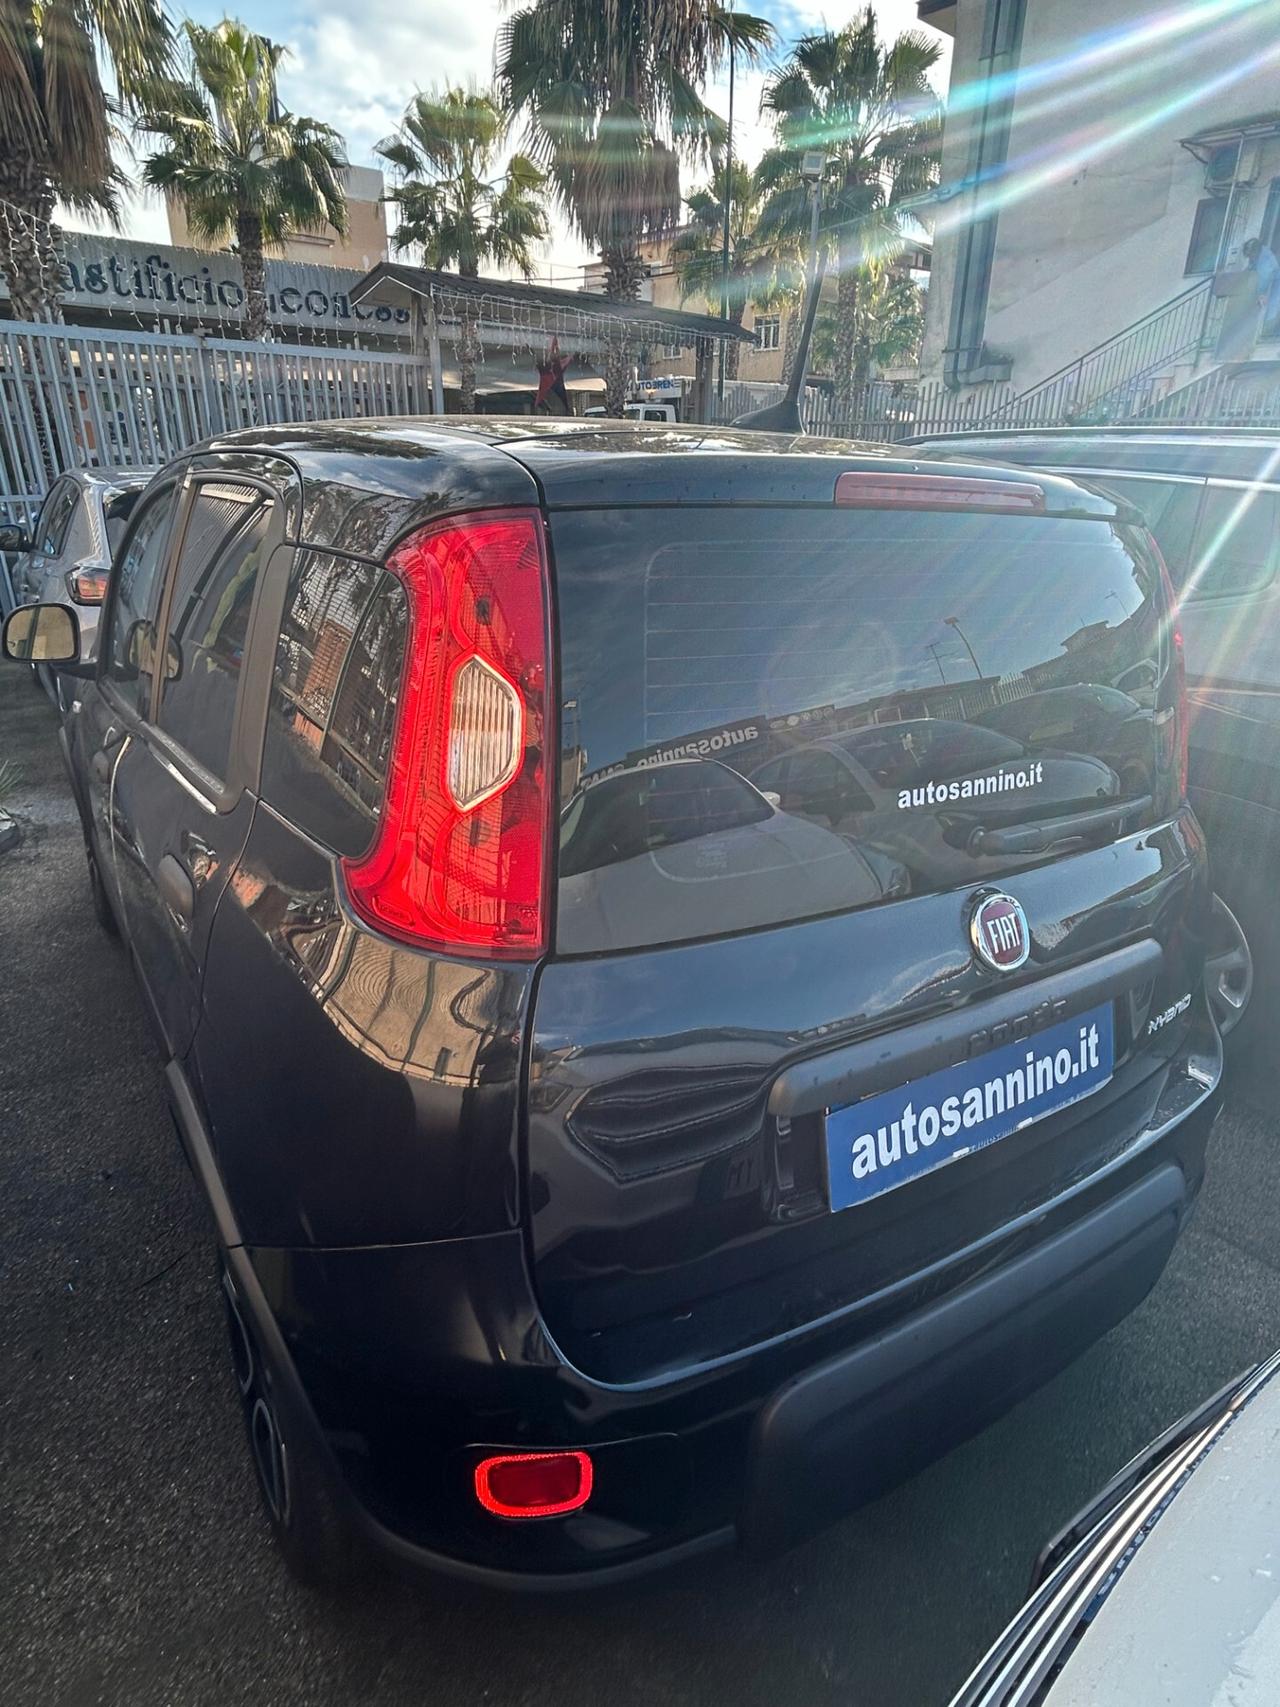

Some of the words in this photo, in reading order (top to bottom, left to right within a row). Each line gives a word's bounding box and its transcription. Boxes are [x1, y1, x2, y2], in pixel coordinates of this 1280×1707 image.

[59, 254, 247, 309] astificio
[897, 761, 1044, 808] autosannino.it
[986, 911, 1021, 954] FIAT
[850, 1023, 1100, 1179] autosannino.it
